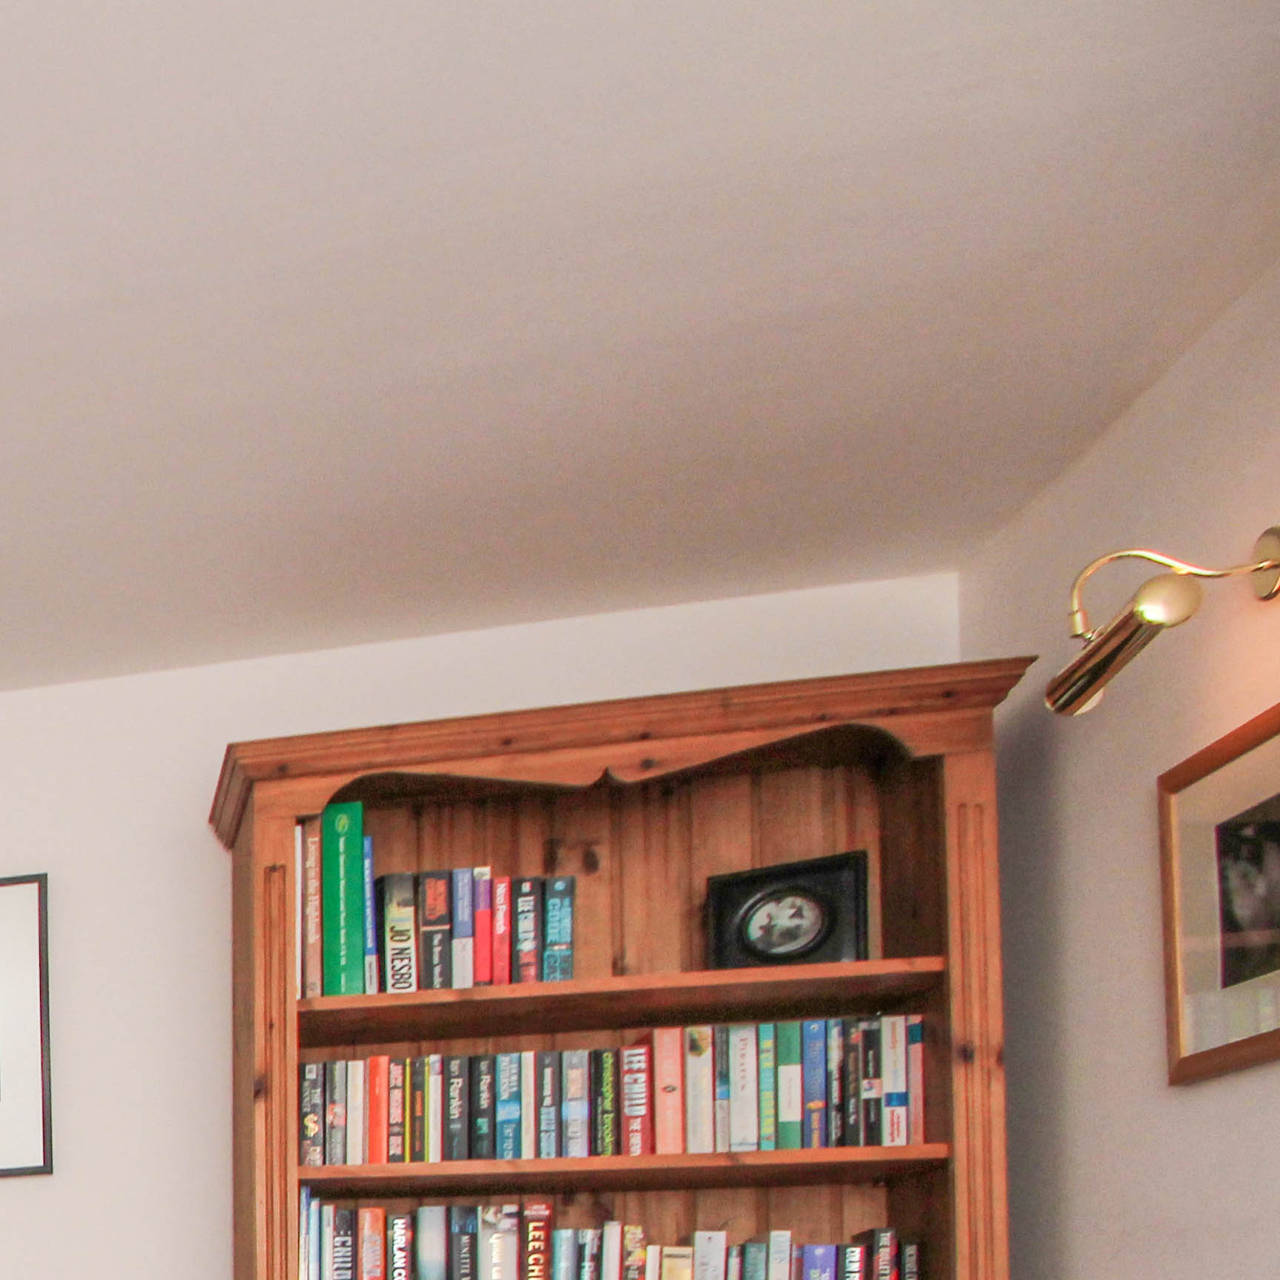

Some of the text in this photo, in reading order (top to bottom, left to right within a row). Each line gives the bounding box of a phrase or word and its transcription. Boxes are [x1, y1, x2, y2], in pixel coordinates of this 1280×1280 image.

[390, 925, 411, 943] JO
[448, 1078, 464, 1119] Rankin
[624, 1049, 647, 1116] LEE CHILD
[392, 1218, 406, 1268] HARLAN
[528, 1221, 545, 1251] LEE
[334, 1236, 352, 1279] CHILD
